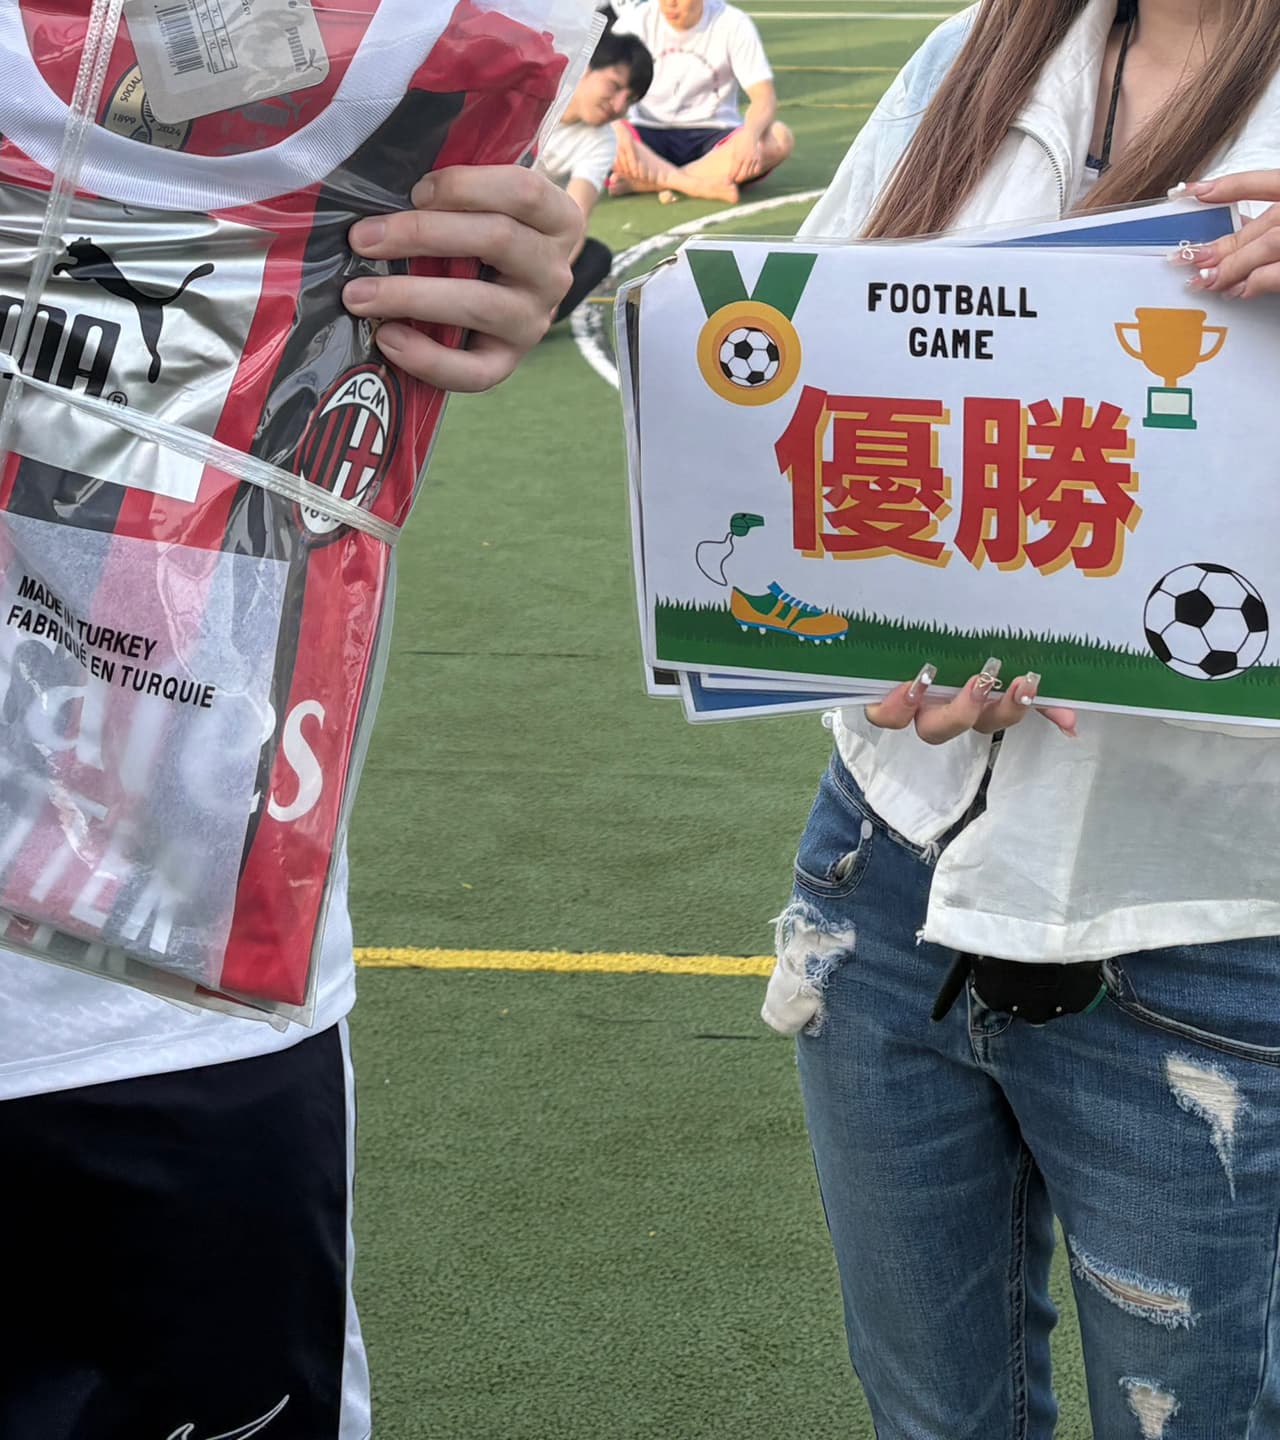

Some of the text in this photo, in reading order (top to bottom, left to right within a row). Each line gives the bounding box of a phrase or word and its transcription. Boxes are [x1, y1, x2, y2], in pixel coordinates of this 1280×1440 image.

[867, 282, 1038, 318] FOOTBALL
[909, 327, 994, 360] GAME
[336, 378, 384, 417] ACM
[774, 384, 1143, 578] 優勝
[17, 575, 63, 618] MADE
[76, 619, 158, 661] TURKEY
[6, 605, 217, 709] FABRIQUÉ EN TURQUIE
